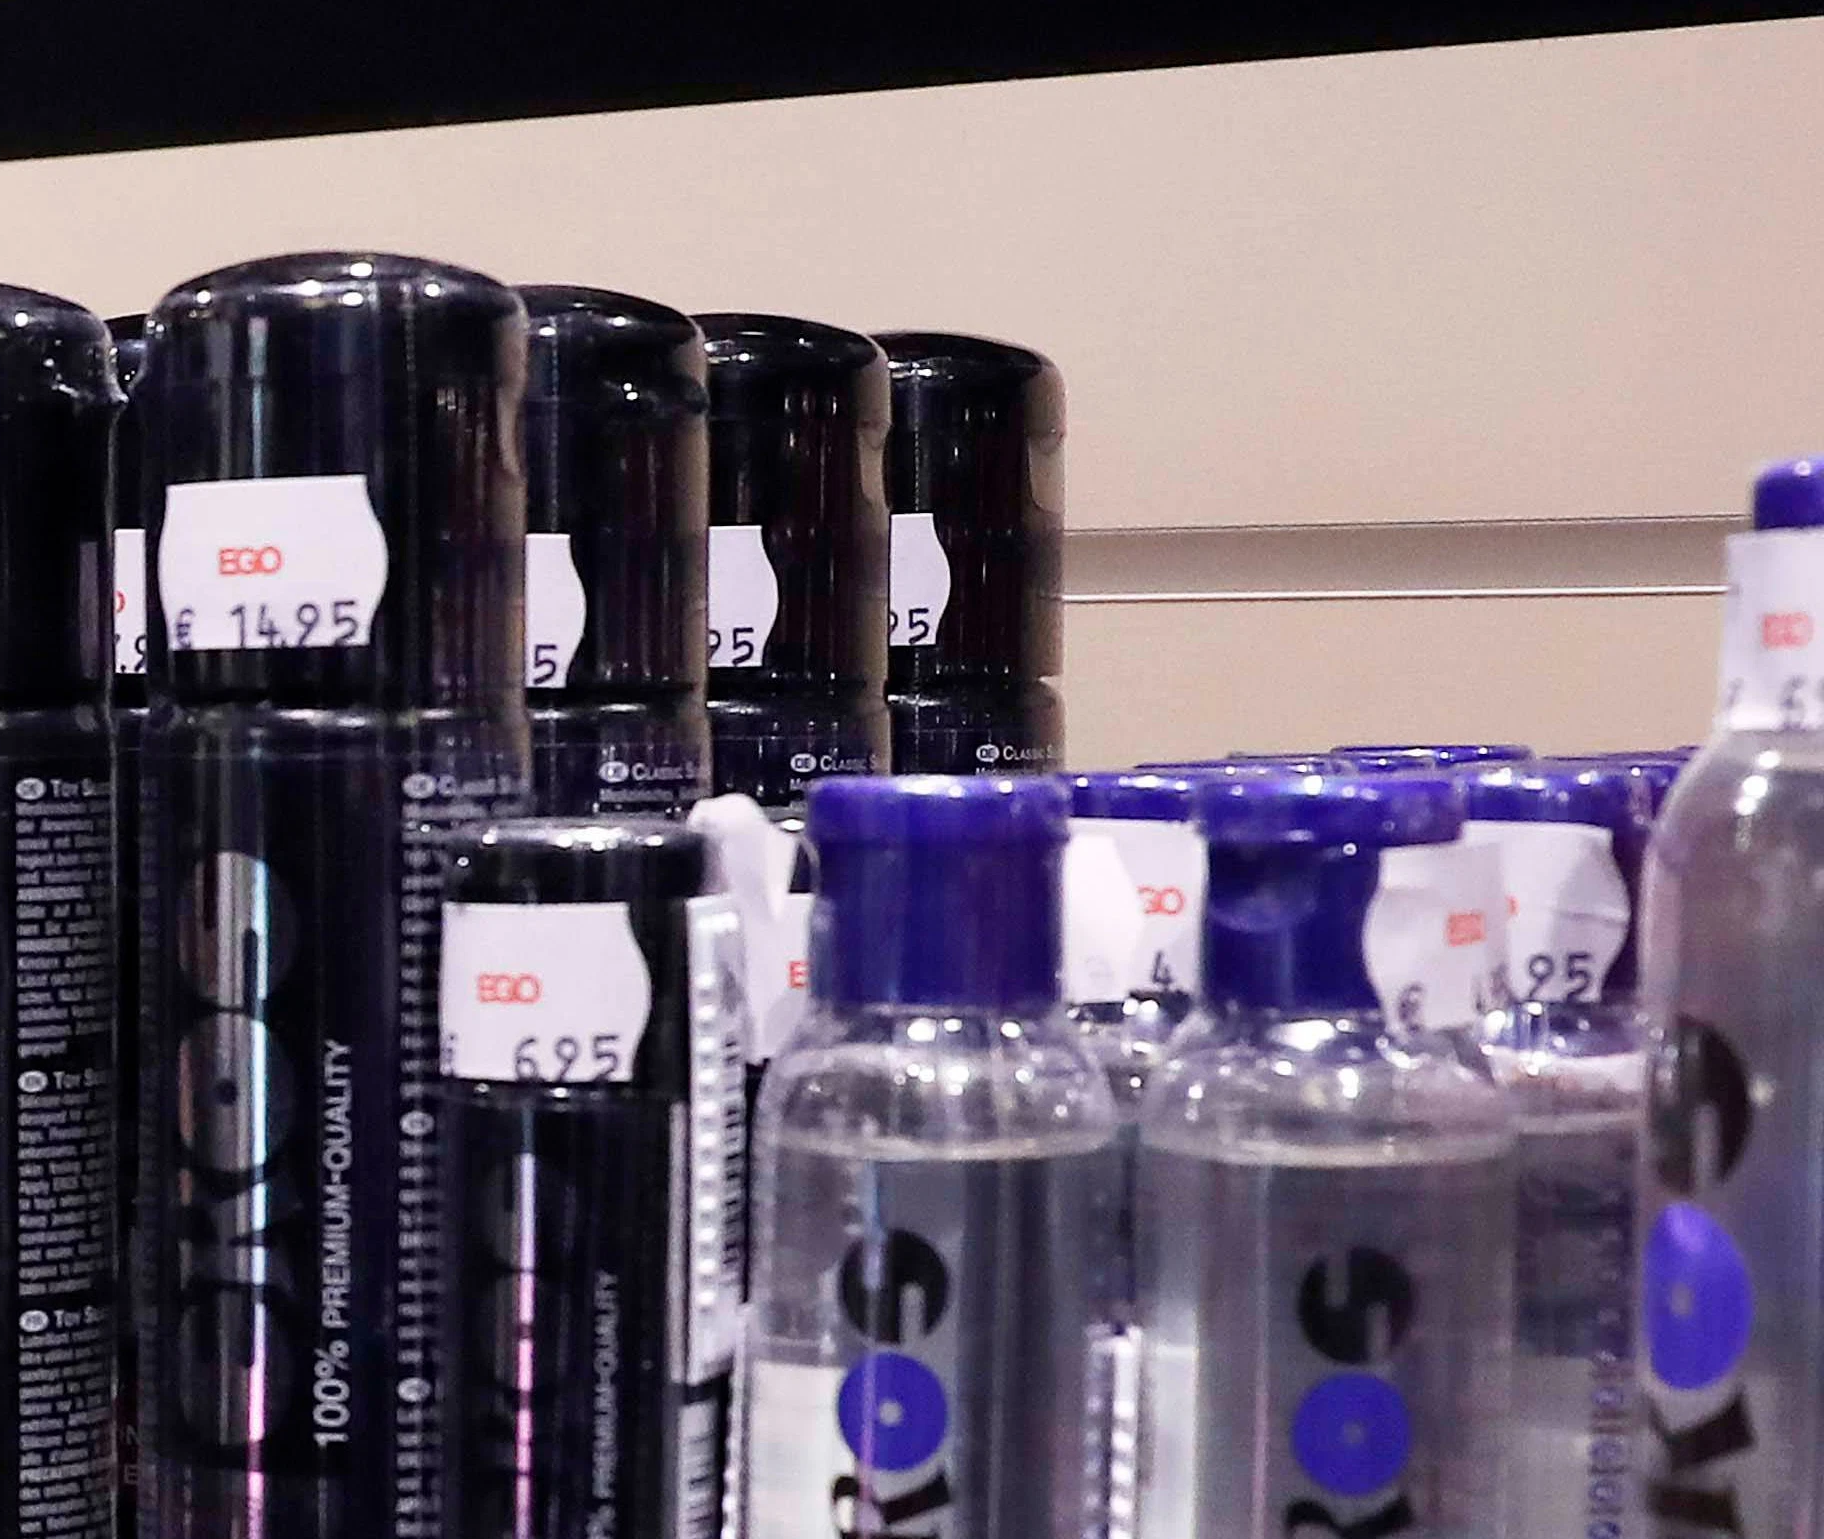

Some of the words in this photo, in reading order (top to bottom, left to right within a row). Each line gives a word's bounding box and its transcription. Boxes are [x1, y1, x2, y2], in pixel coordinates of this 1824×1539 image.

[219, 547, 282, 575] EGO
[230, 601, 359, 648] 14.95
[478, 973, 542, 1003] EGO
[321, 1037, 351, 1329] PREMIUM-QUALITY
[313, 1339, 350, 1448] 100%
